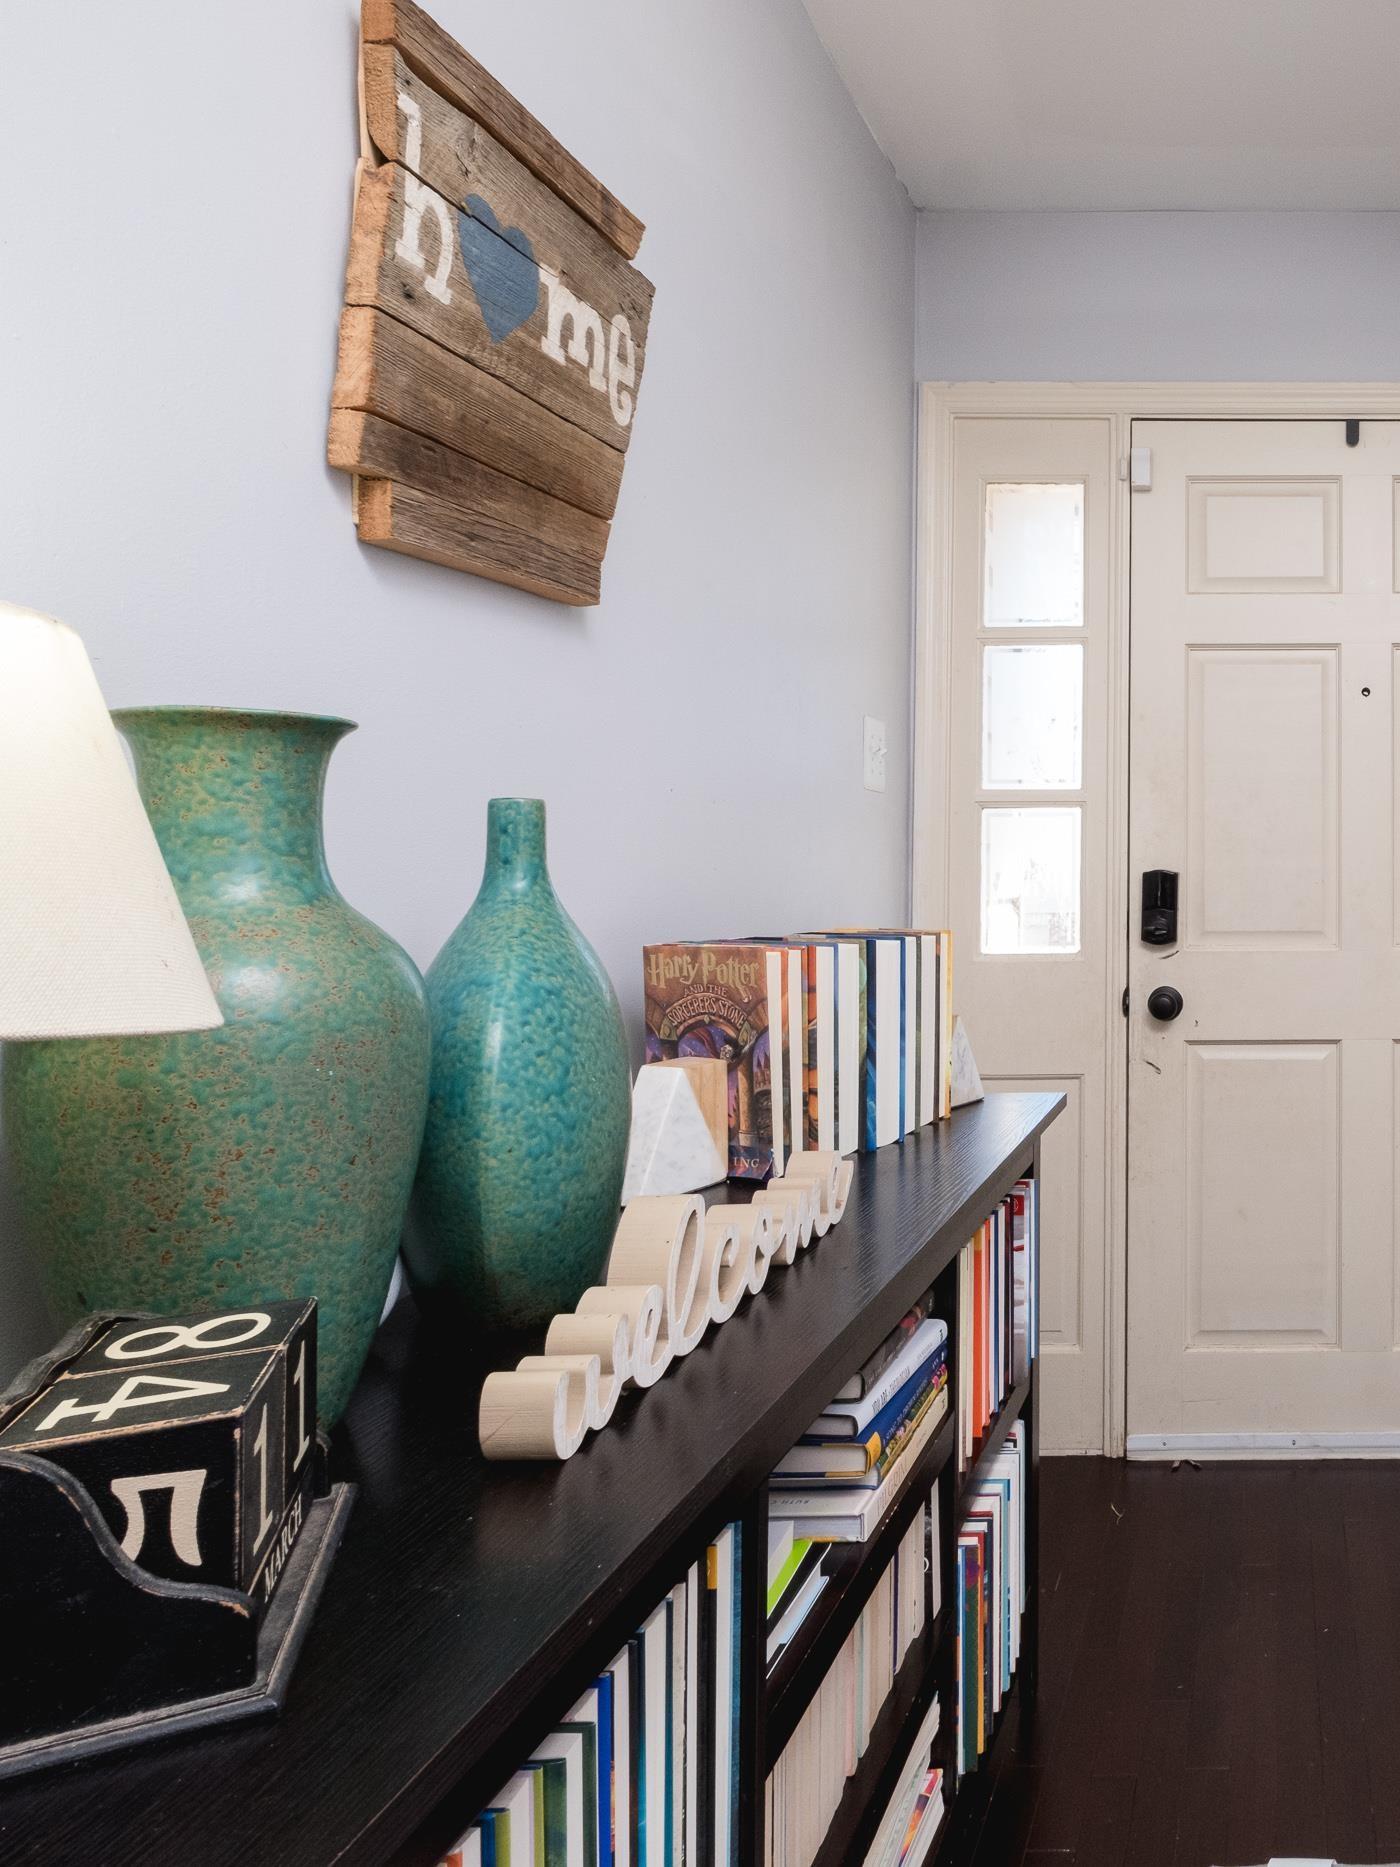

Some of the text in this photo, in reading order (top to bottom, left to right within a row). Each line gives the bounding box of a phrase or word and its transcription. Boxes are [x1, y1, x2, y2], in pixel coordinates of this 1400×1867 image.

[647, 948, 760, 1003] Harry Potter
[684, 984, 728, 998] AND THE
[719, 1000, 748, 1031] STONE
[263, 1492, 302, 1604] MARCH
